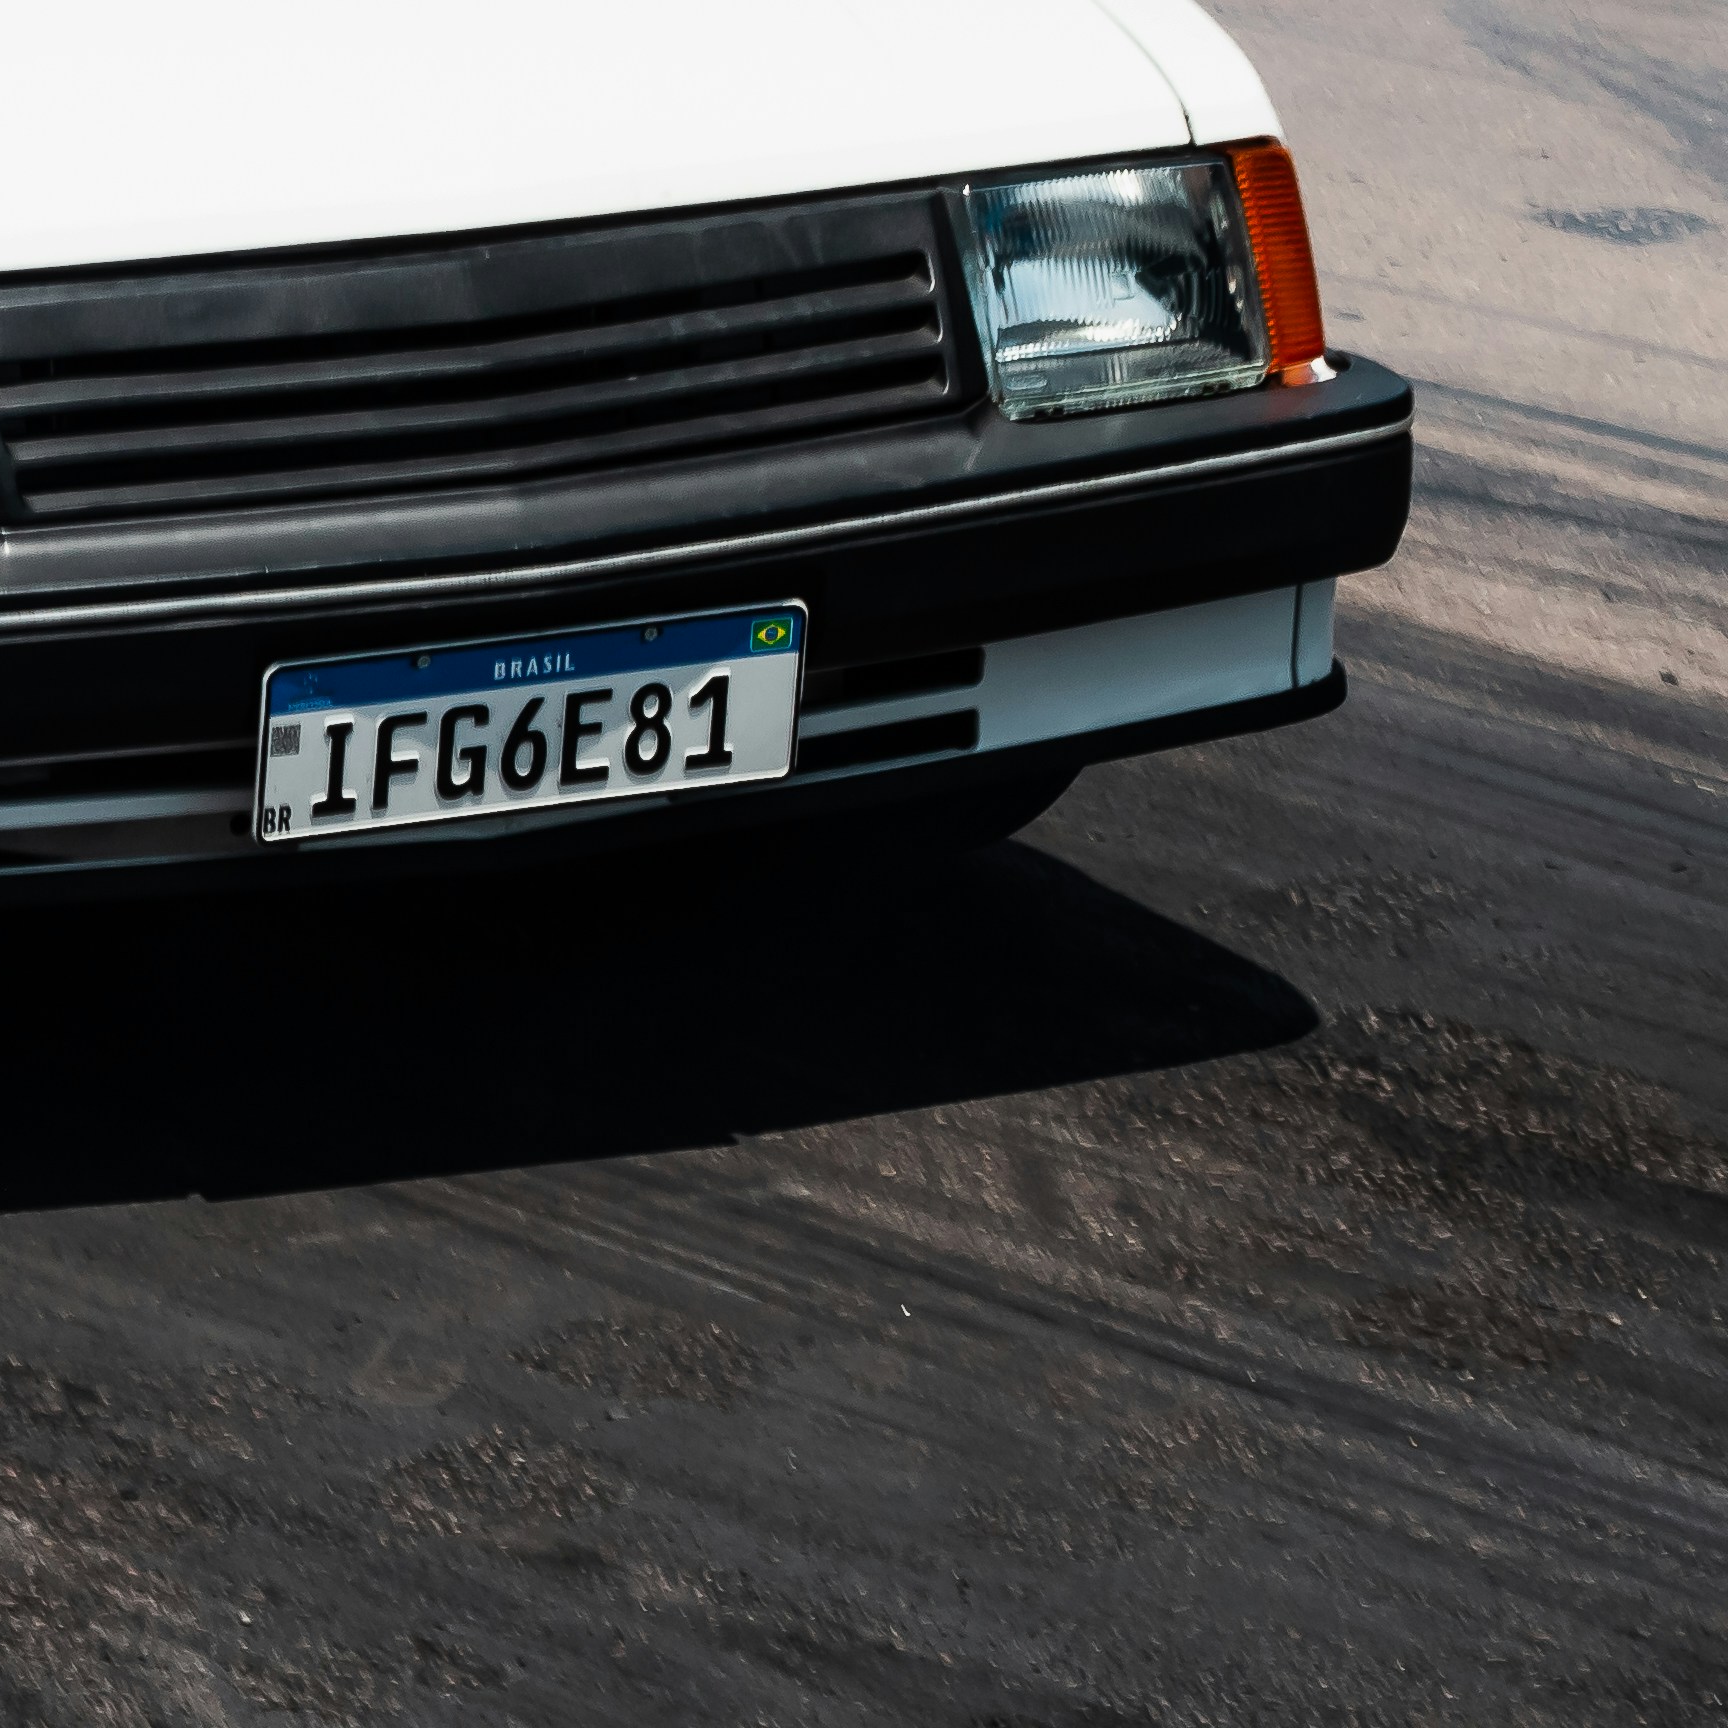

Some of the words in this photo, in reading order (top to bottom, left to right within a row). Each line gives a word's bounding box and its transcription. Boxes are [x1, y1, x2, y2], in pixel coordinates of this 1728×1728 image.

[494, 652, 576, 681] BRASIL
[310, 674, 734, 819] IFG6E81
[263, 804, 292, 833] BR
